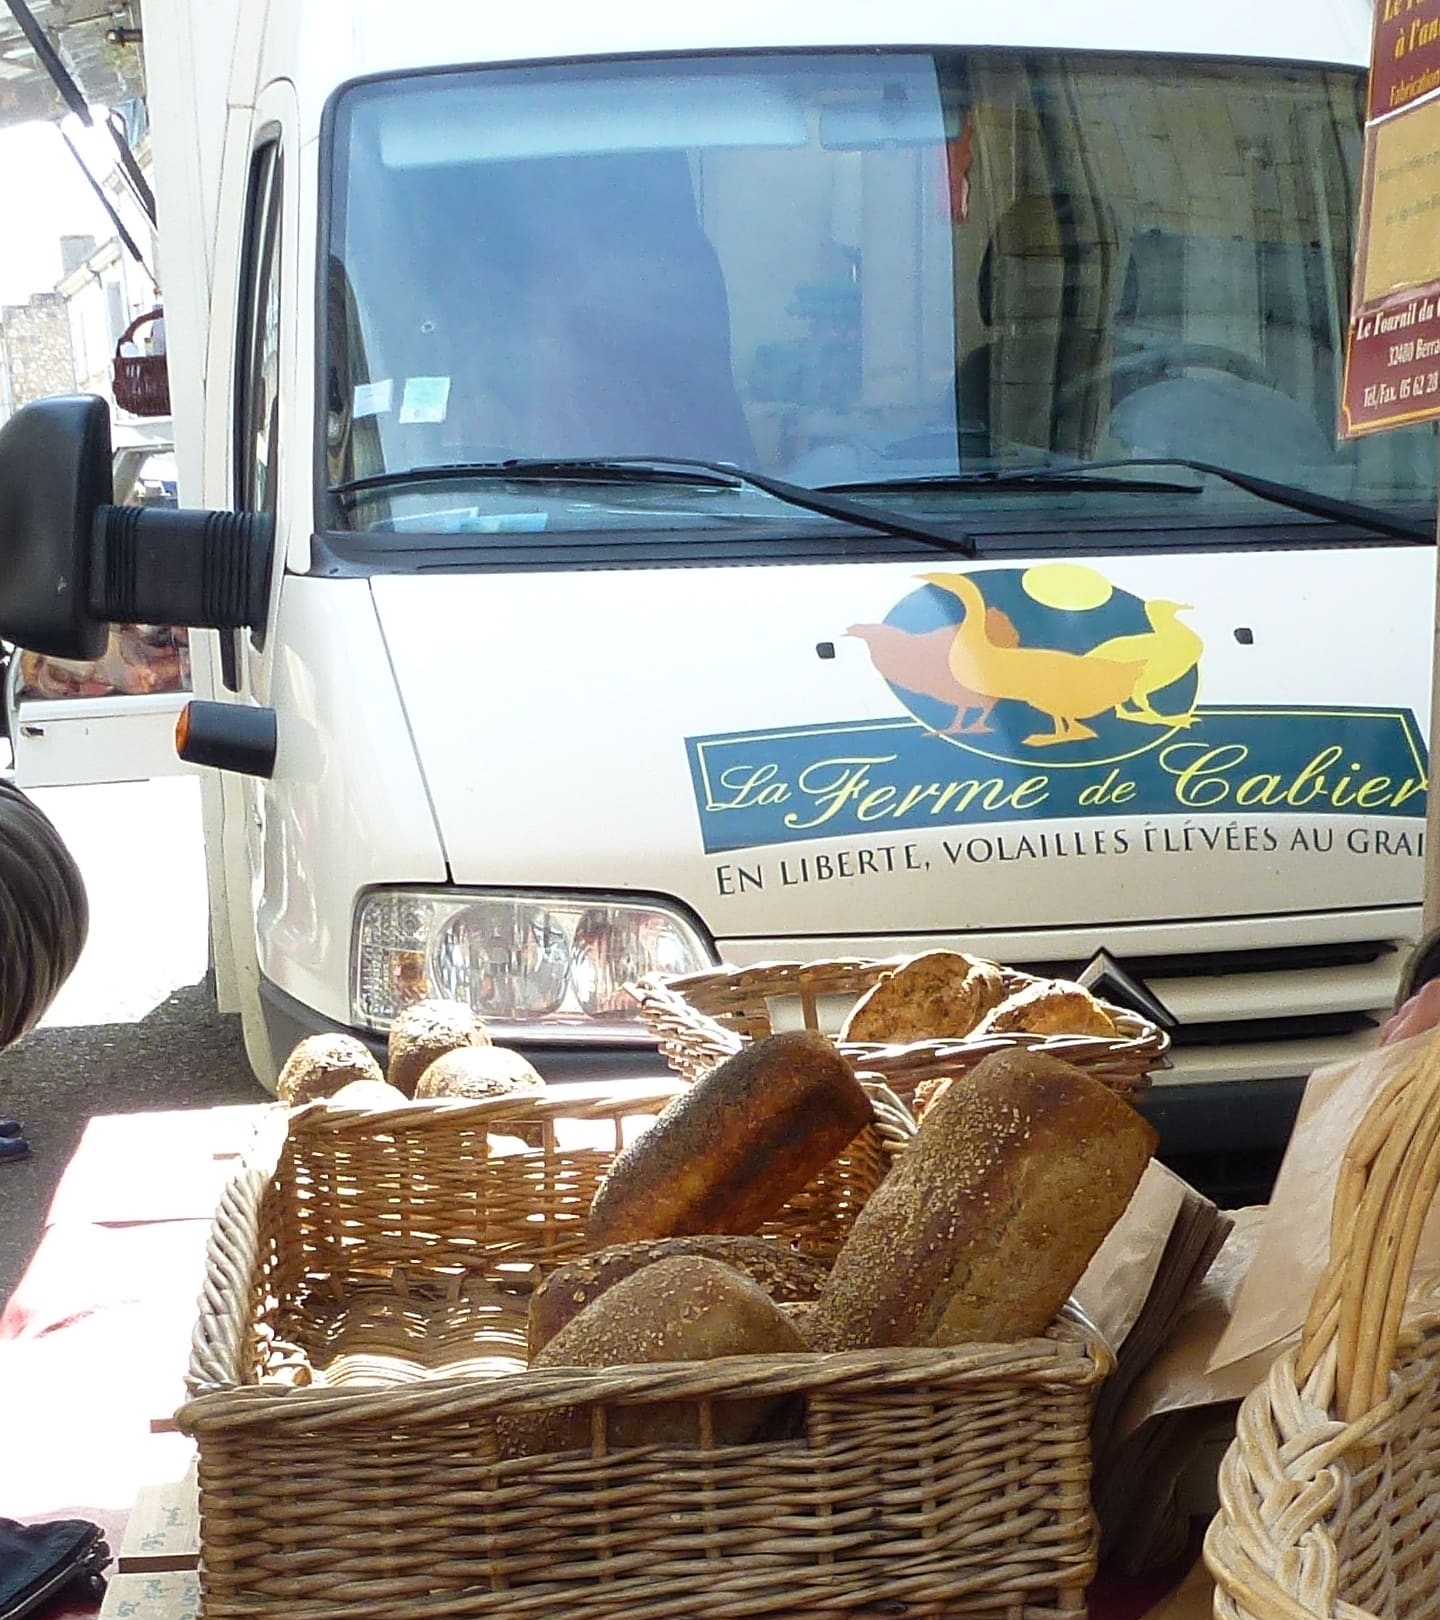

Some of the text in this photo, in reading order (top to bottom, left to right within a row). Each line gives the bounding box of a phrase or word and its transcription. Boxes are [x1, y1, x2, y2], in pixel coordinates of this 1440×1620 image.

[1356, 317, 1370, 341] Le
[1373, 302, 1417, 337] Fournil
[1418, 298, 1434, 323] du
[706, 764, 793, 812] La
[783, 754, 1050, 829] Ferme
[1077, 768, 1138, 806] de
[715, 864, 763, 896] EN
[942, 828, 1130, 865] VOLAILLES
[1289, 828, 1334, 854] AU
[1346, 828, 1425, 858] GRAI
